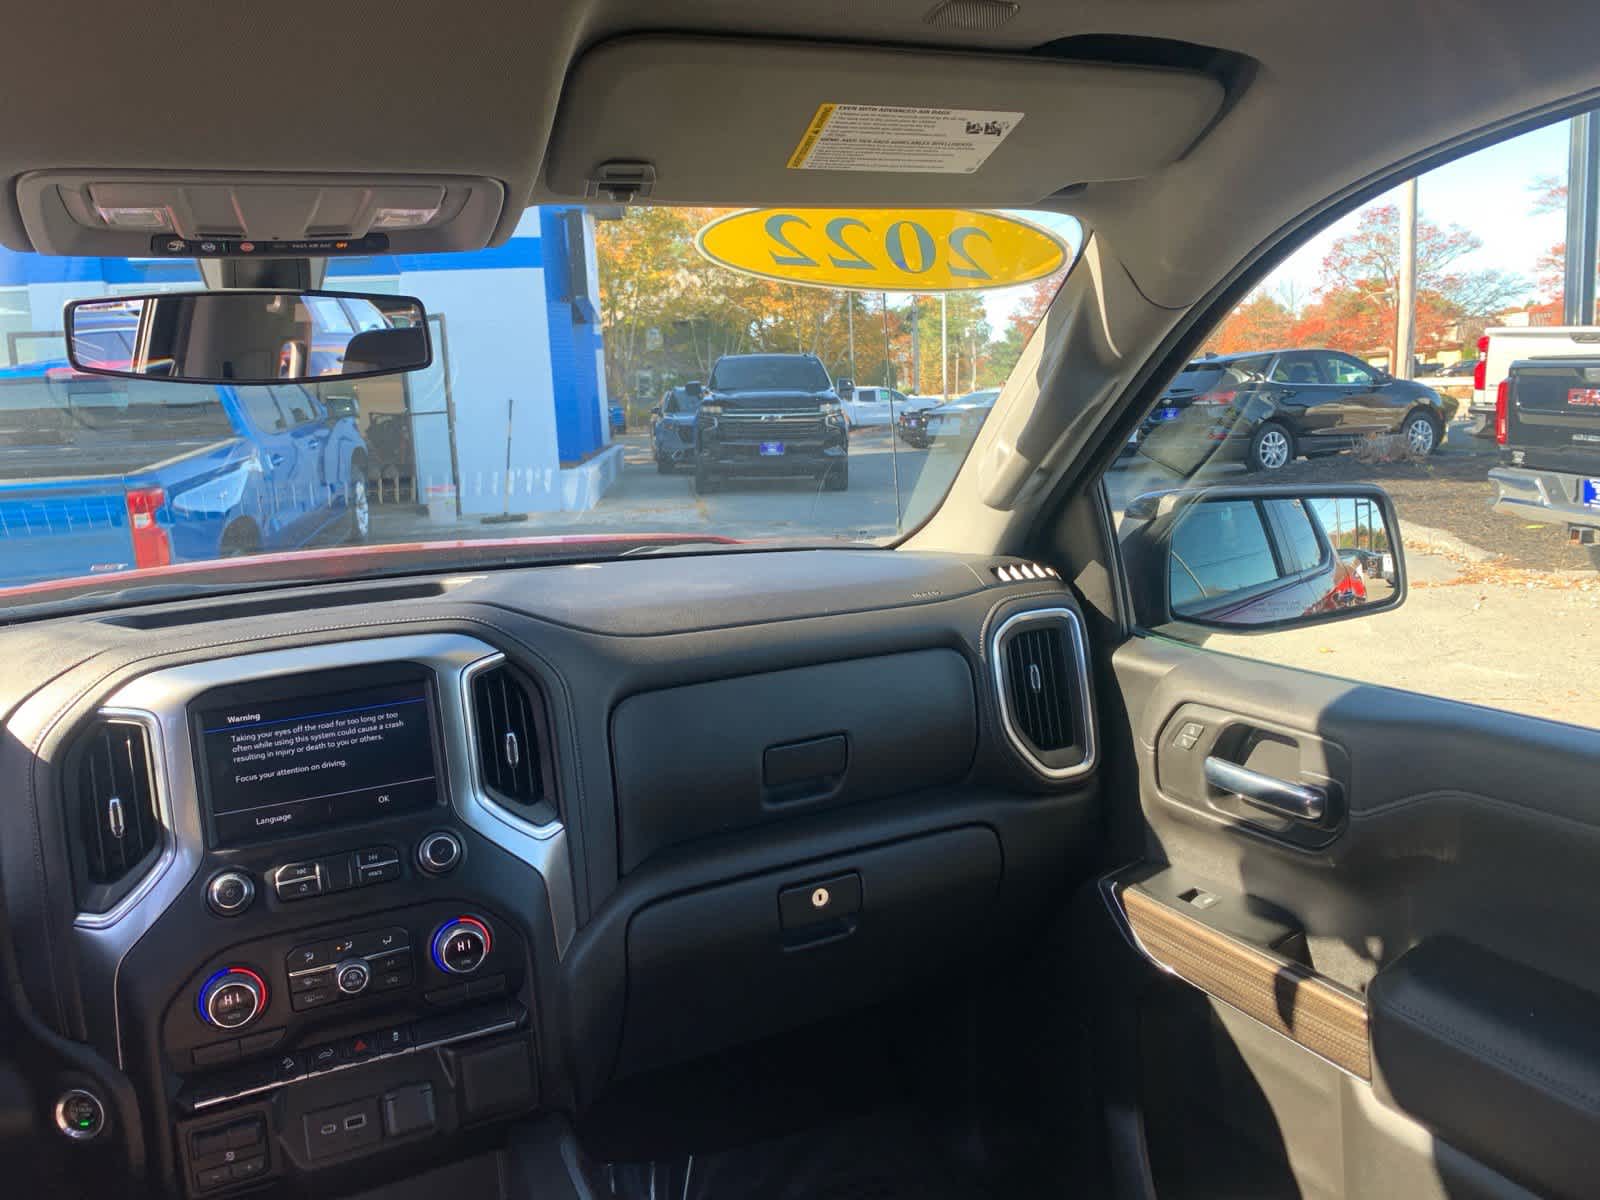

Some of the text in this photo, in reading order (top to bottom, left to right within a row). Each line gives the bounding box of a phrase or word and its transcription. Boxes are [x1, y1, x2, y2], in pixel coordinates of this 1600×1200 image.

[227, 713, 261, 723] Warning
[231, 733, 256, 743] Taking
[257, 731, 273, 740] your
[274, 729, 292, 737] eyes
[293, 725, 303, 734] off
[304, 724, 317, 732] the
[318, 720, 334, 729] road
[335, 719, 346, 727] for
[360, 715, 376, 723] long
[232, 743, 253, 753] often
[254, 741, 273, 750] while
[274, 738, 294, 746] using
[295, 734, 309, 743] this
[310, 731, 336, 742] system
[337, 728, 357, 737] could
[357, 725, 378, 733] cause
[385, 720, 404, 729] crash
[233, 752, 266, 763] resulting
[275, 748, 295, 758] injury
[305, 742, 327, 751] death
[336, 739, 350, 748] you
[359, 734, 384, 743] others.
[235, 774, 258, 784] Focus
[259, 771, 275, 781] your
[276, 765, 310, 777] attention
[321, 759, 348, 769] driving.
[378, 795, 390, 804] OK
[255, 812, 293, 826] Language
[457, 939, 471, 952] HI
[224, 991, 240, 1006] HI
